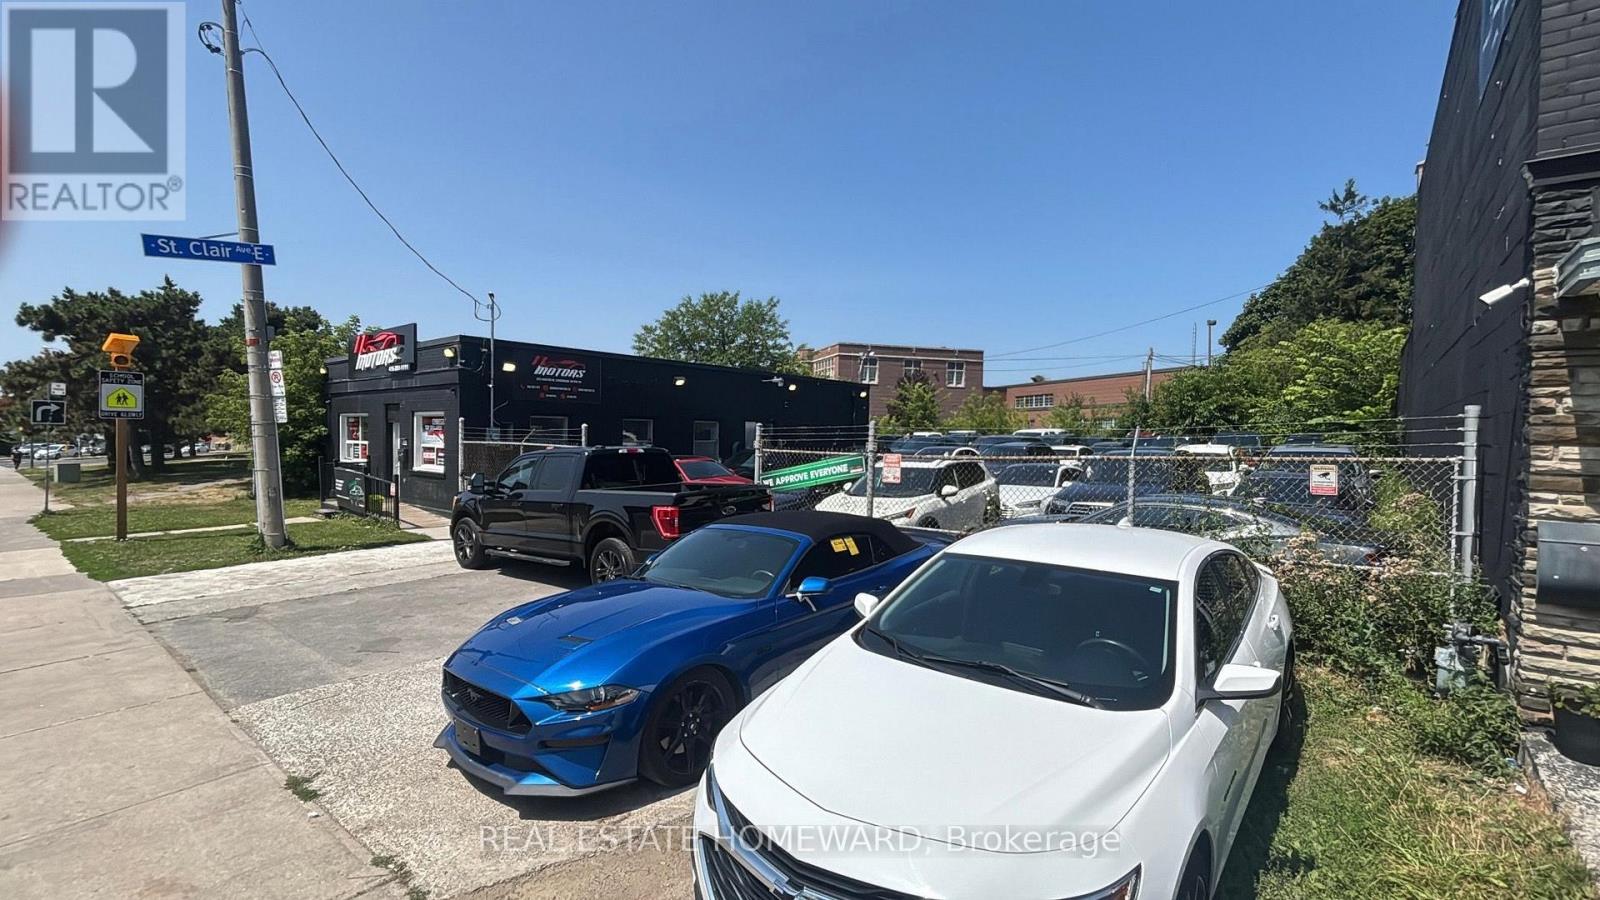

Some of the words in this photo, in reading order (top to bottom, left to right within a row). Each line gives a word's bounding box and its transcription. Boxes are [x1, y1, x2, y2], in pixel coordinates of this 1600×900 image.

[157, 238, 183, 255] St.
[189, 241, 232, 258] Clair
[254, 246, 265, 261] E
[355, 346, 401, 371] MOTORS
[534, 365, 586, 378] MOTORS
[776, 473, 808, 486] APPROVE
[810, 463, 848, 479] EVERYONE
